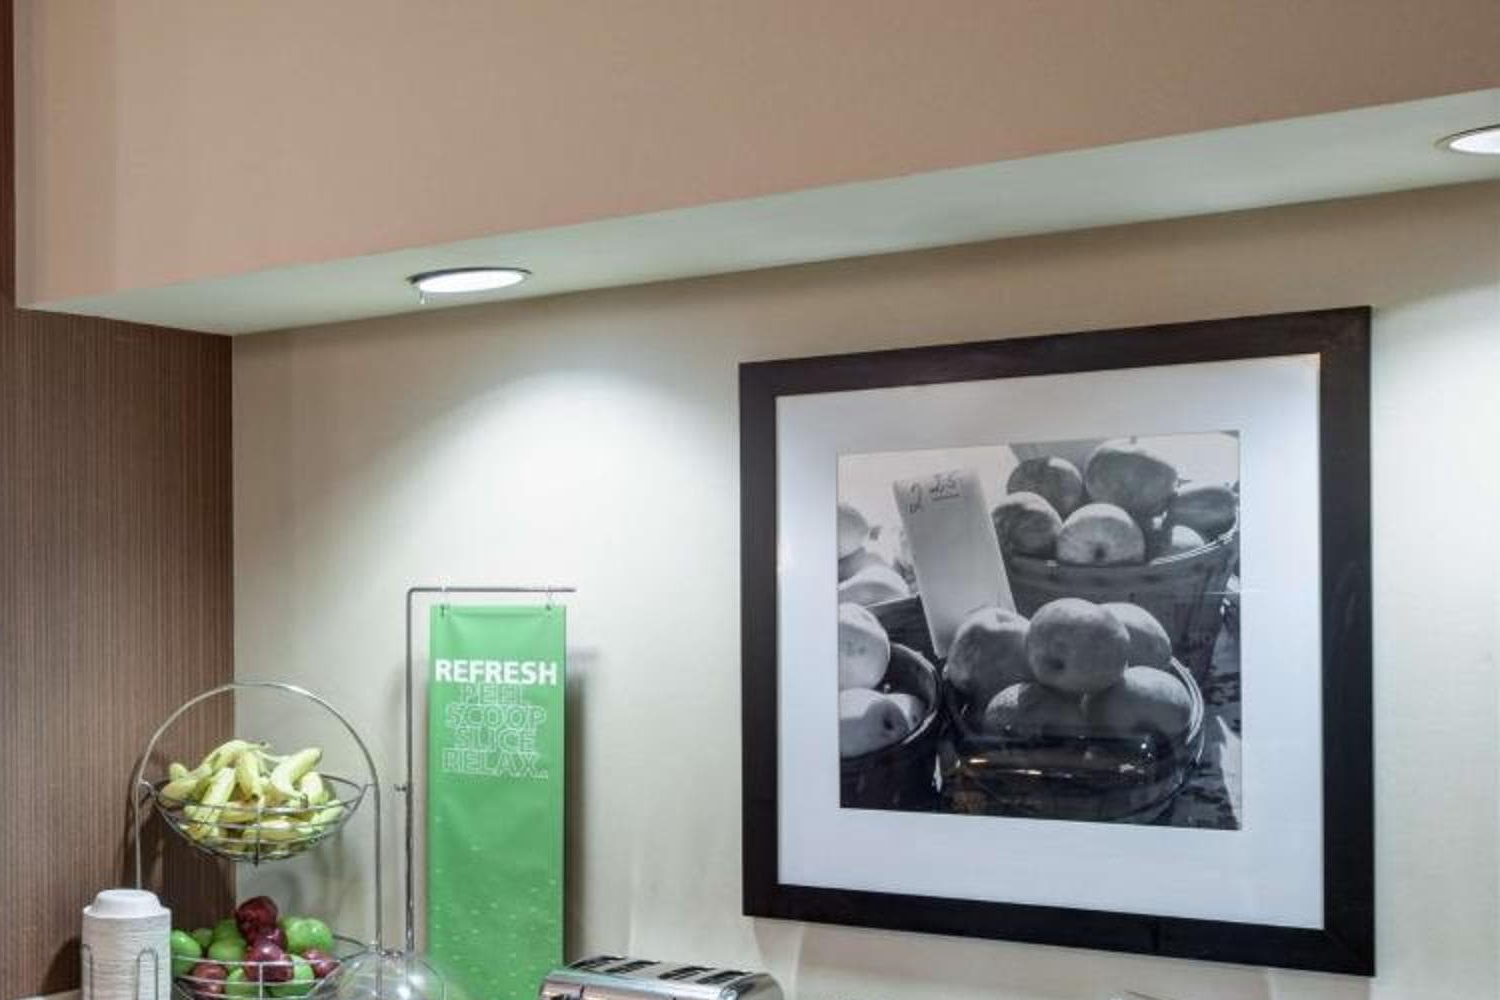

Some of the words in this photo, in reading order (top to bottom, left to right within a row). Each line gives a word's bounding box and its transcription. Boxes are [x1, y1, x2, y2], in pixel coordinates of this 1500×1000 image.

[435, 659, 557, 685] REFRESH
[447, 703, 547, 729] SCOOP
[454, 727, 536, 752] SLICE
